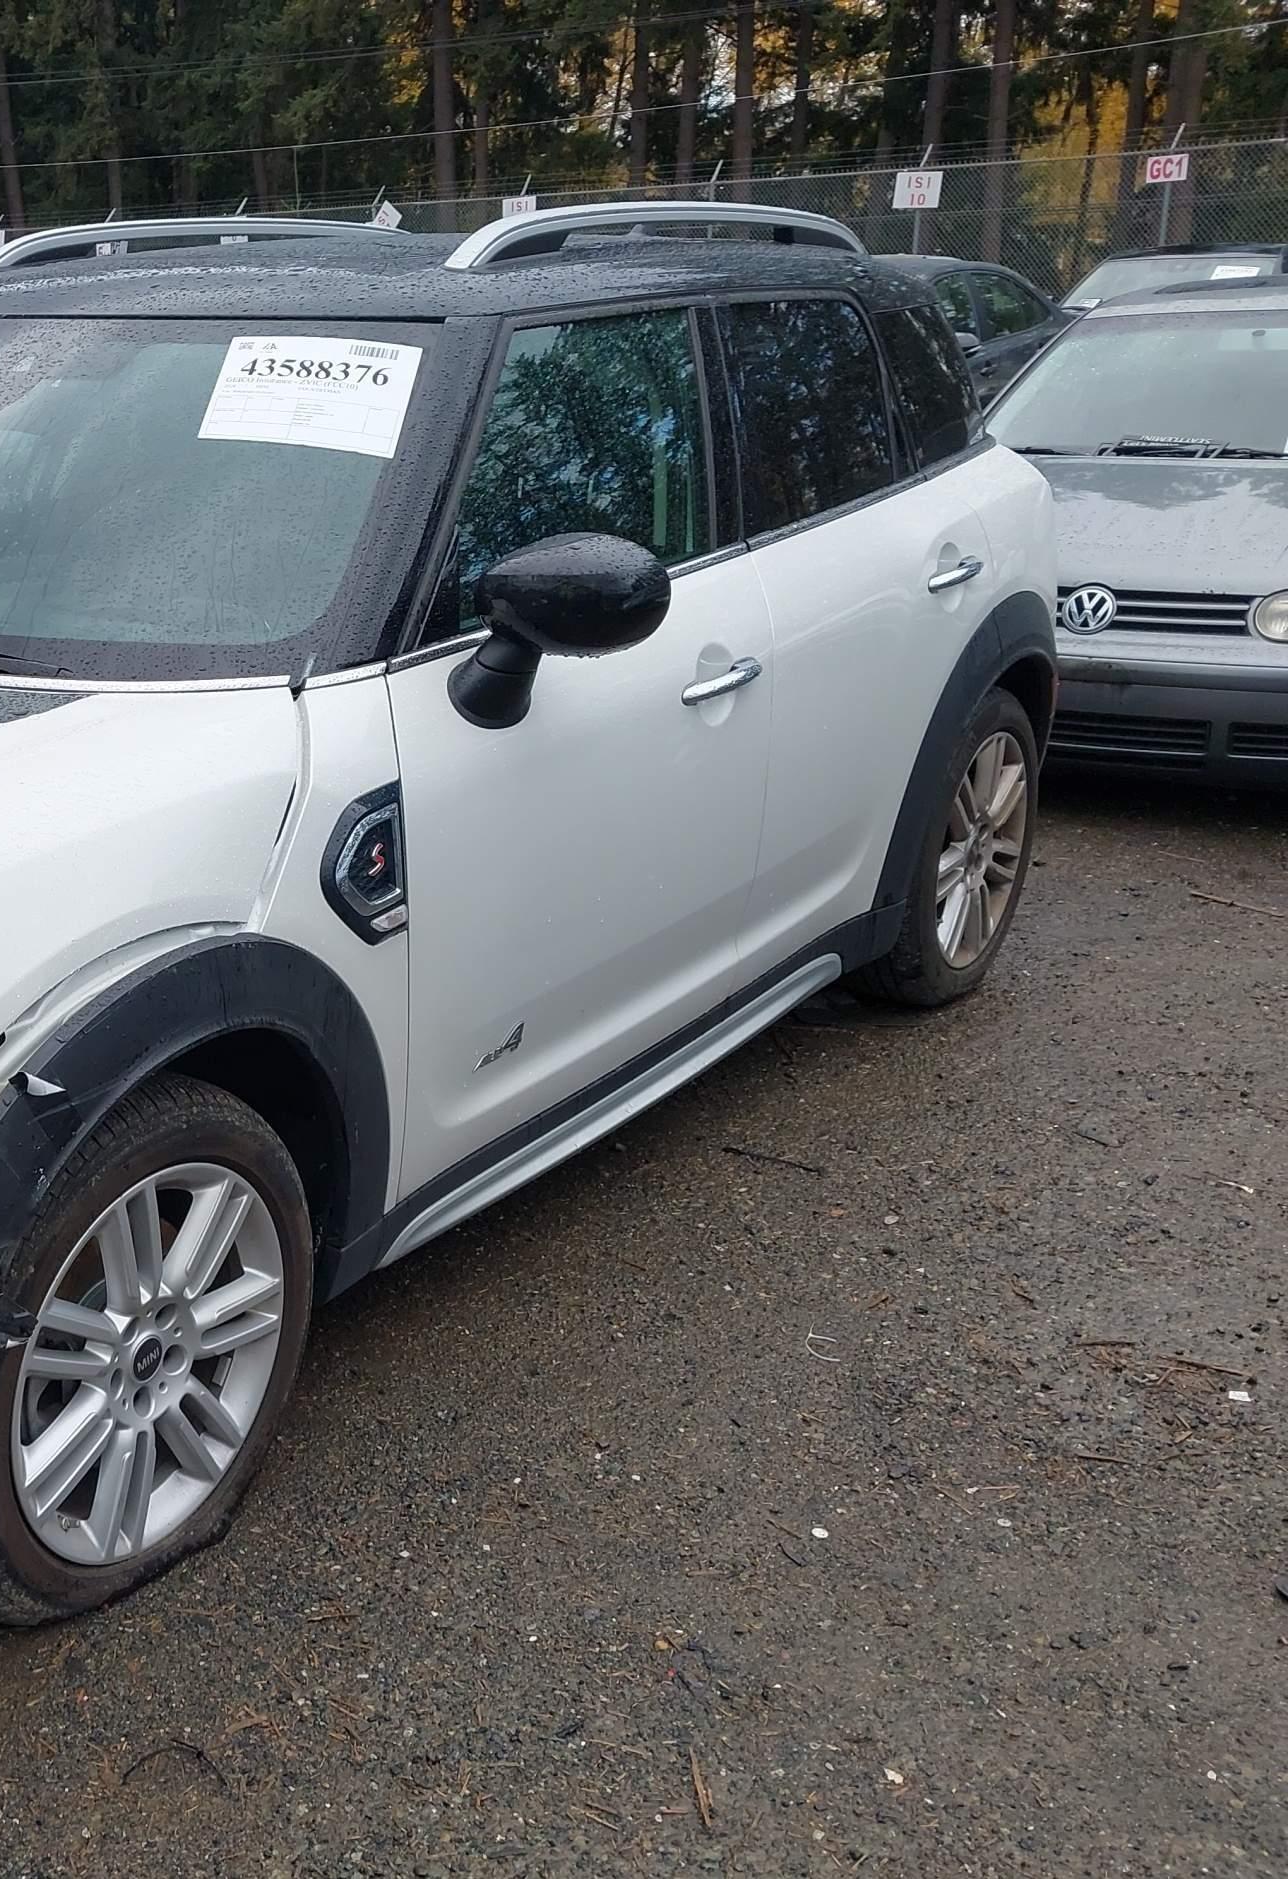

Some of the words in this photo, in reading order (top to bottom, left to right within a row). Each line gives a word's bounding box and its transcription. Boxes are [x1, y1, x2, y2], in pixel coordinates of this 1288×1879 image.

[1150, 157, 1183, 180] GC1
[240, 358, 392, 386] 43588376
[136, 1346, 161, 1373] MINI
